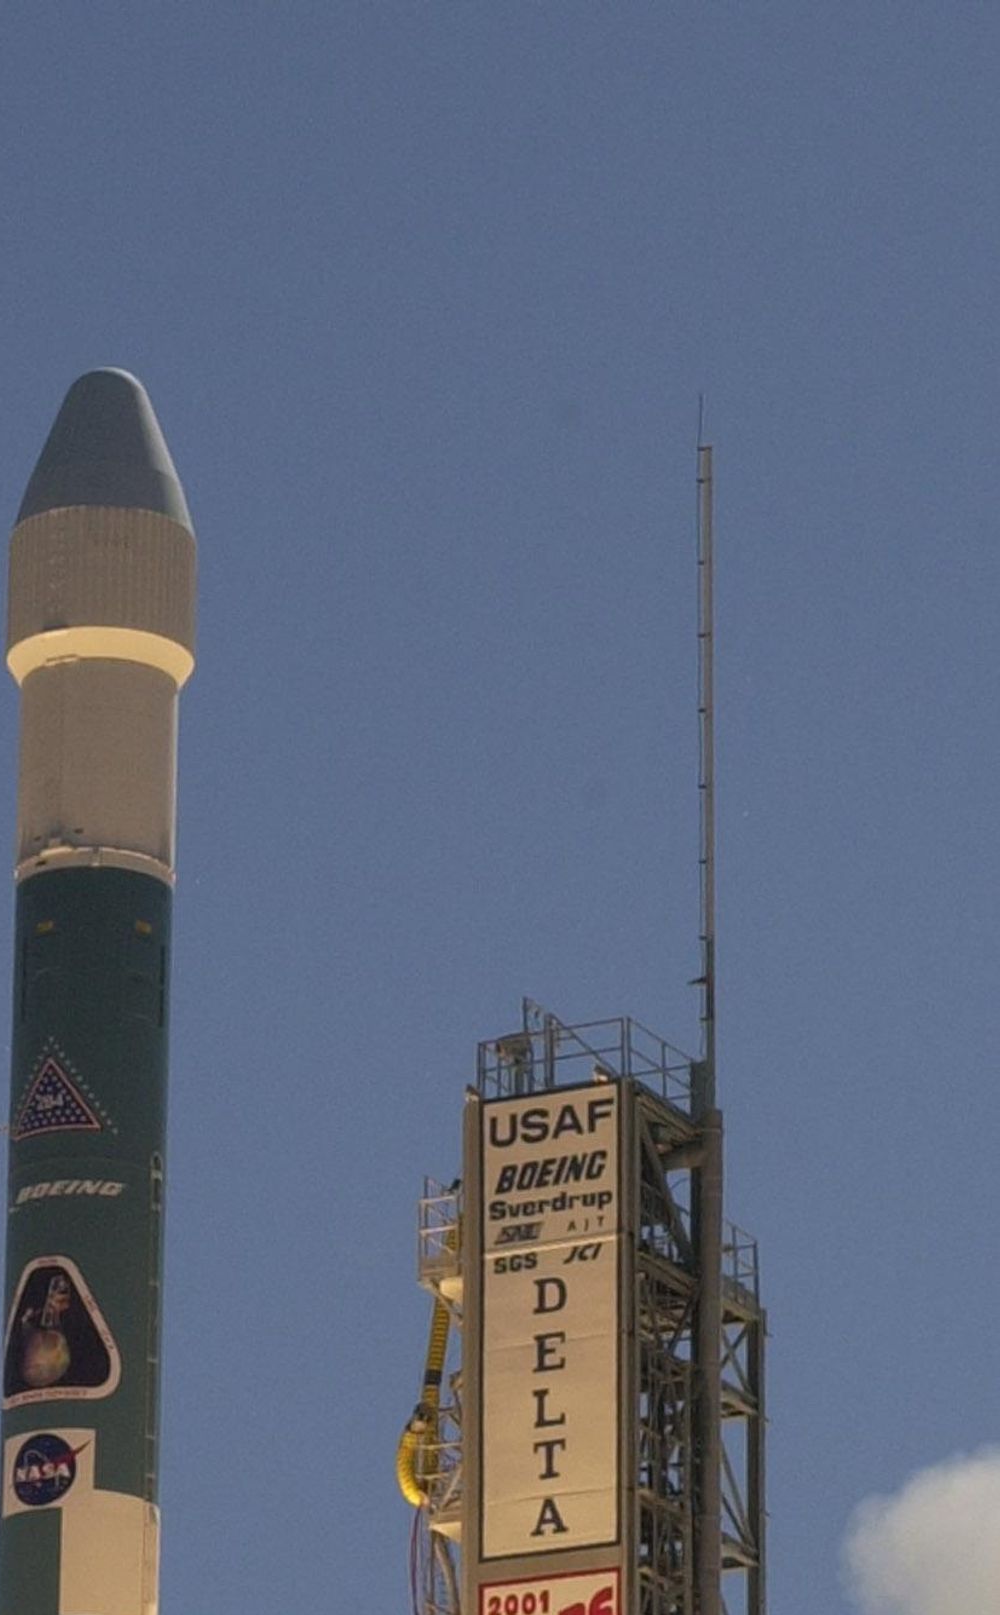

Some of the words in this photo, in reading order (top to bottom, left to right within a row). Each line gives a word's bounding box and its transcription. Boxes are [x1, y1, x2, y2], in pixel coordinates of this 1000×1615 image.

[490, 1099, 614, 1147] USAF
[495, 1150, 607, 1194] BOEING
[16, 1180, 125, 1204] BOEING
[489, 1191, 612, 1221] Sverdrup
[494, 1253, 538, 1274] SGS
[530, 1277, 568, 1537] DELTA
[16, 1462, 70, 1482] NASA
